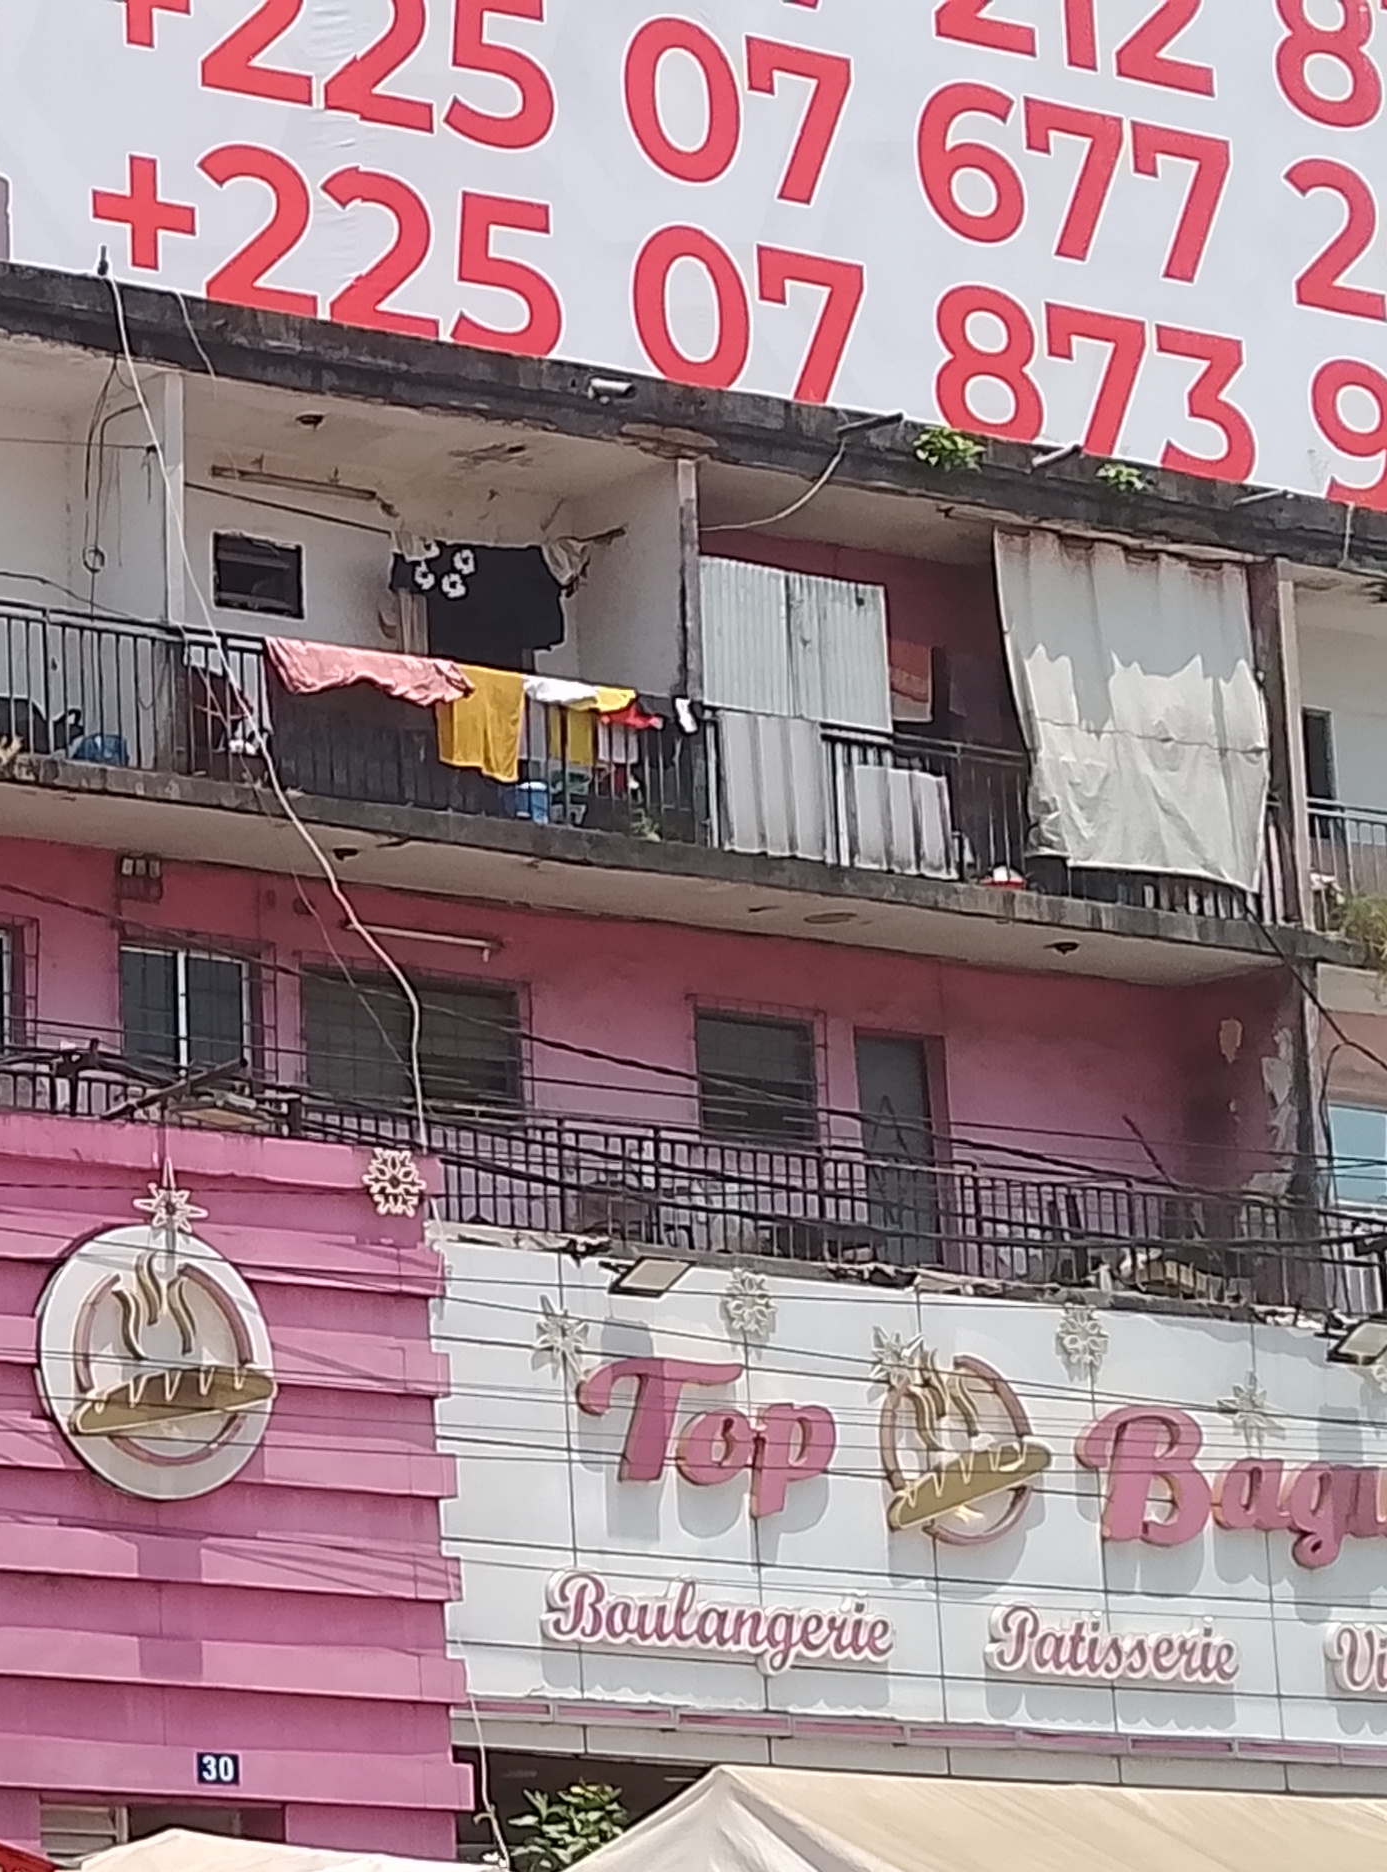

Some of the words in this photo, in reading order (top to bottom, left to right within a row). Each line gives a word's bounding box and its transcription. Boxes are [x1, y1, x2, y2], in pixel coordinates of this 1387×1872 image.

[623, 17, 852, 205] 07
[917, 82, 1231, 284] 677
[91, 144, 562, 358] +225
[633, 225, 865, 405] 07
[935, 285, 1256, 485] 873
[577, 1356, 837, 1519] Top
[546, 1569, 896, 1676] Boulangerie
[990, 1602, 1242, 1683] Patisserie
[201, 1754, 235, 1782] 30
